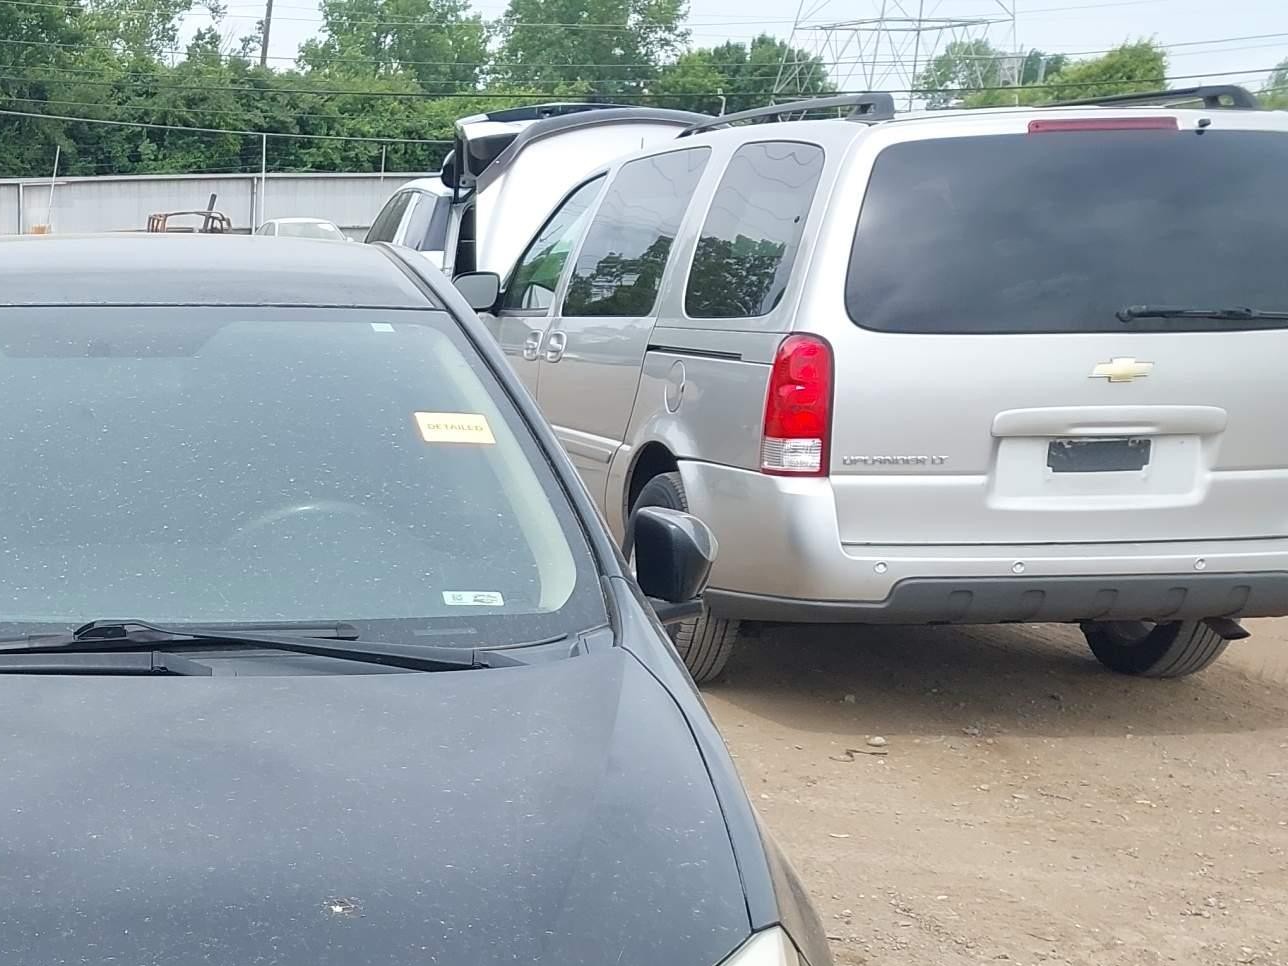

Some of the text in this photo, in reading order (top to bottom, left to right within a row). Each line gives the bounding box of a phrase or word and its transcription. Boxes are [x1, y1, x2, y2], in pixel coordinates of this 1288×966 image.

[427, 423, 484, 432] DETAILED
[842, 455, 950, 466] UPLANDER LT
